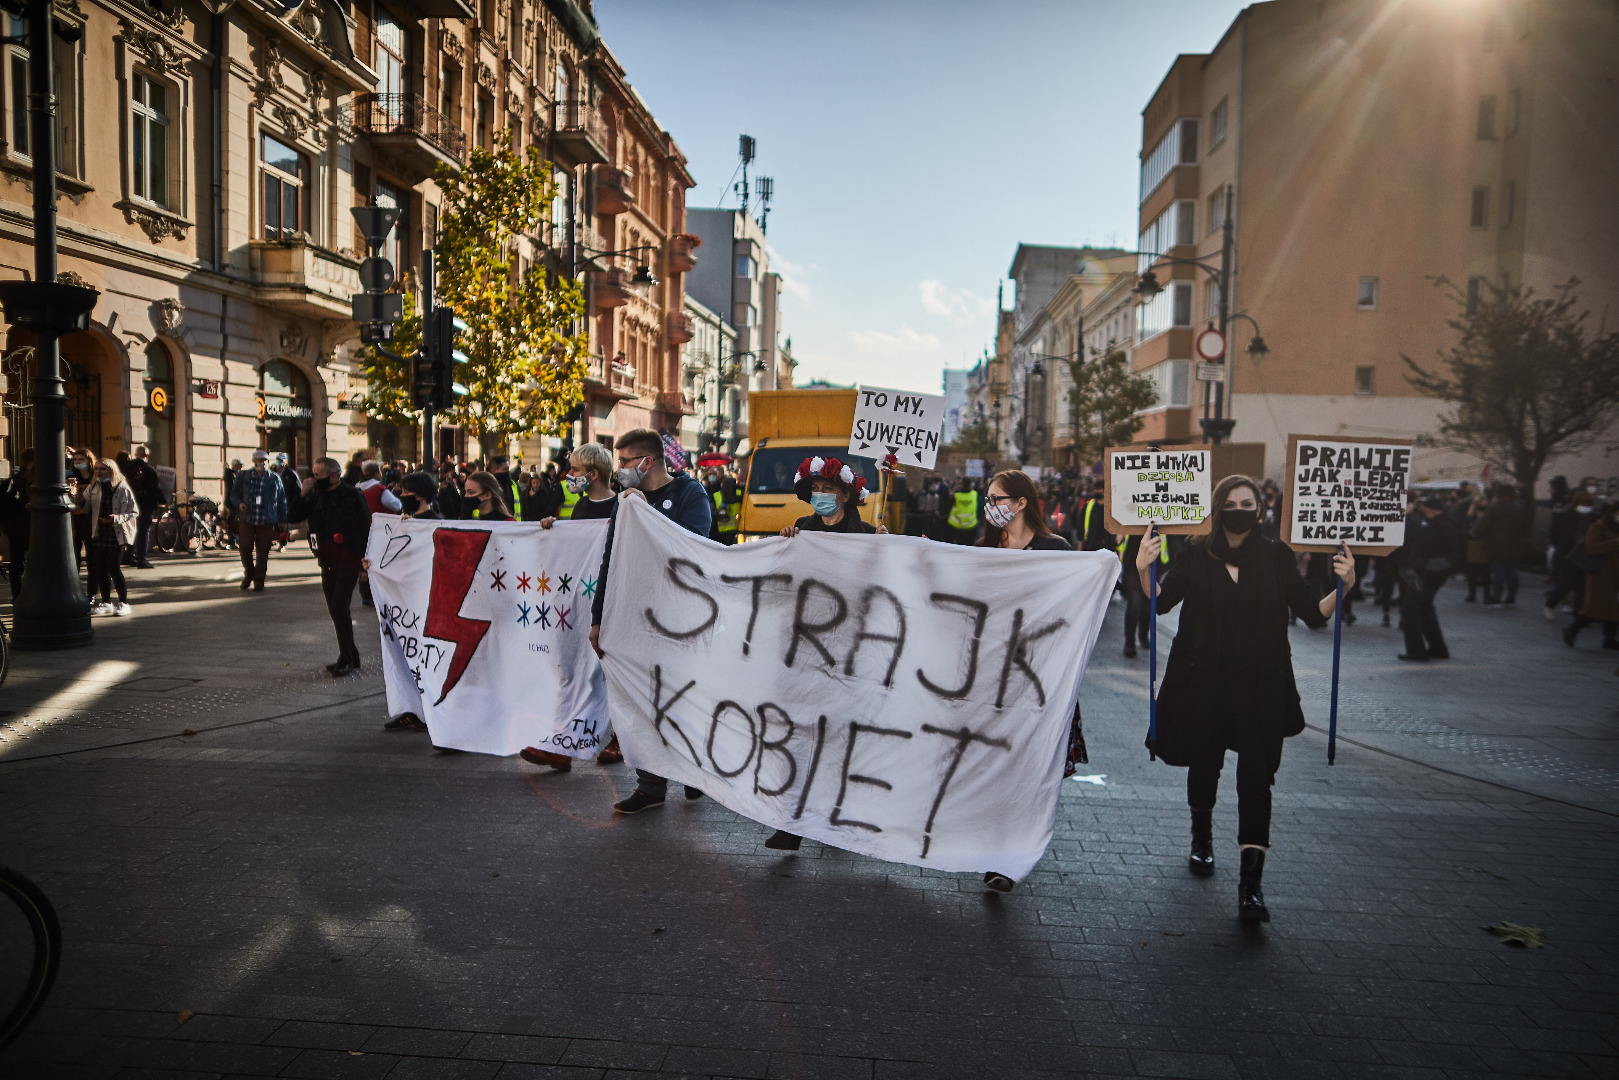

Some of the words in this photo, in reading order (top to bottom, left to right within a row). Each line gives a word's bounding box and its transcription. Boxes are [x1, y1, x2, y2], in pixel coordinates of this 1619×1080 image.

[266, 402, 313, 418] GOLDENMARK
[861, 390, 887, 408] TO
[894, 394, 925, 417] MY,
[853, 419, 939, 452] SUWEREN
[1114, 455, 1150, 470] NIE
[1157, 452, 1204, 472] WTYKAJ
[1299, 445, 1410, 472] PRAWIE
[1137, 471, 1194, 482] DZIOBA
[1298, 468, 1341, 482] JAK
[1155, 482, 1168, 492] W
[1299, 486, 1311, 496] Z
[1138, 505, 1205, 520] MAJTKI
[1322, 510, 1356, 522] NAS
[1302, 525, 1384, 542] KACZKI
[644, 556, 1070, 710] STRAJK
[653, 663, 1012, 859] KOBIET
